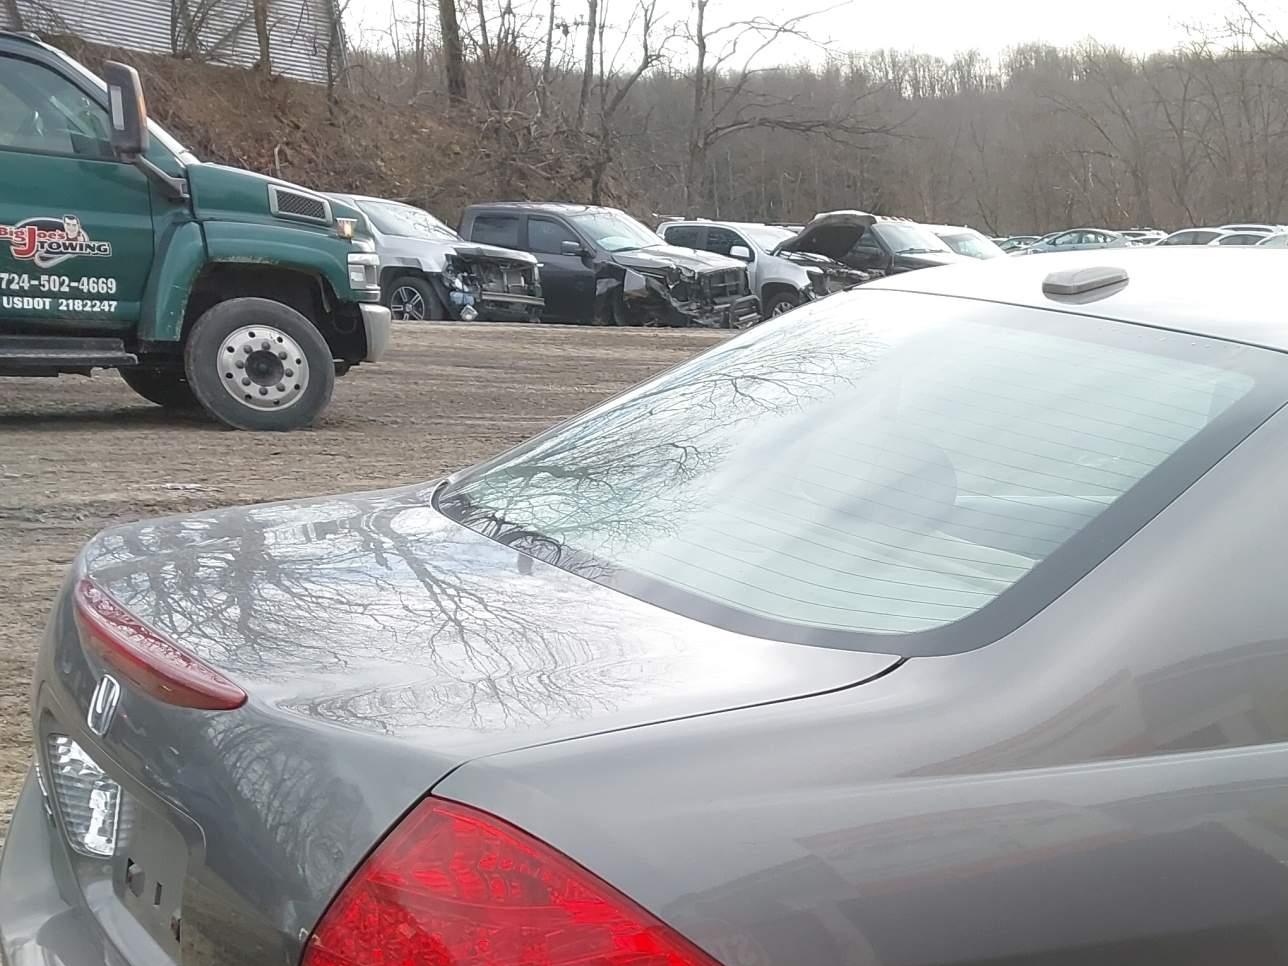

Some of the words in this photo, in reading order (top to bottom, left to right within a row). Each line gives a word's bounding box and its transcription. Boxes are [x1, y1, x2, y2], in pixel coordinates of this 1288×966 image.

[38, 241, 109, 253] TOWING
[0, 272, 117, 294] 724-502-4669
[2, 296, 52, 310] USDOT
[58, 298, 118, 312] 2182247
